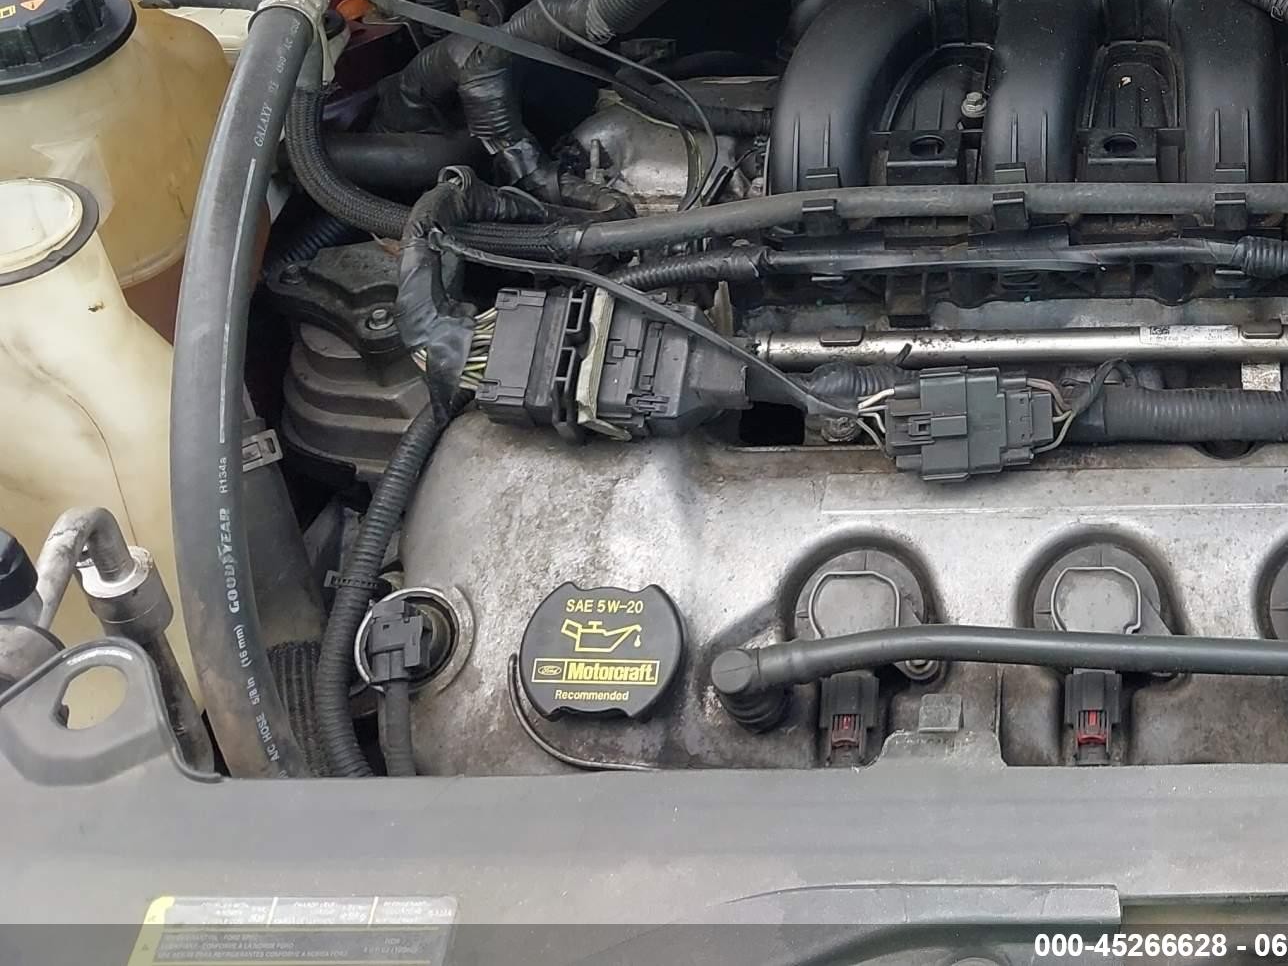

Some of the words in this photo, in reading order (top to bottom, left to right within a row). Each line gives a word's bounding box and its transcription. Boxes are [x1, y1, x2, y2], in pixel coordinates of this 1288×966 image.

[253, 101, 273, 147] GALAXY
[218, 456, 229, 494] R134a
[218, 508, 240, 614] GOODYEAR
[566, 598, 594, 613] SAE
[597, 599, 643, 614] 5W-20
[567, 662, 655, 682] Motorcraft
[555, 689, 630, 702] Recommended
[256, 713, 275, 744] HOSE
